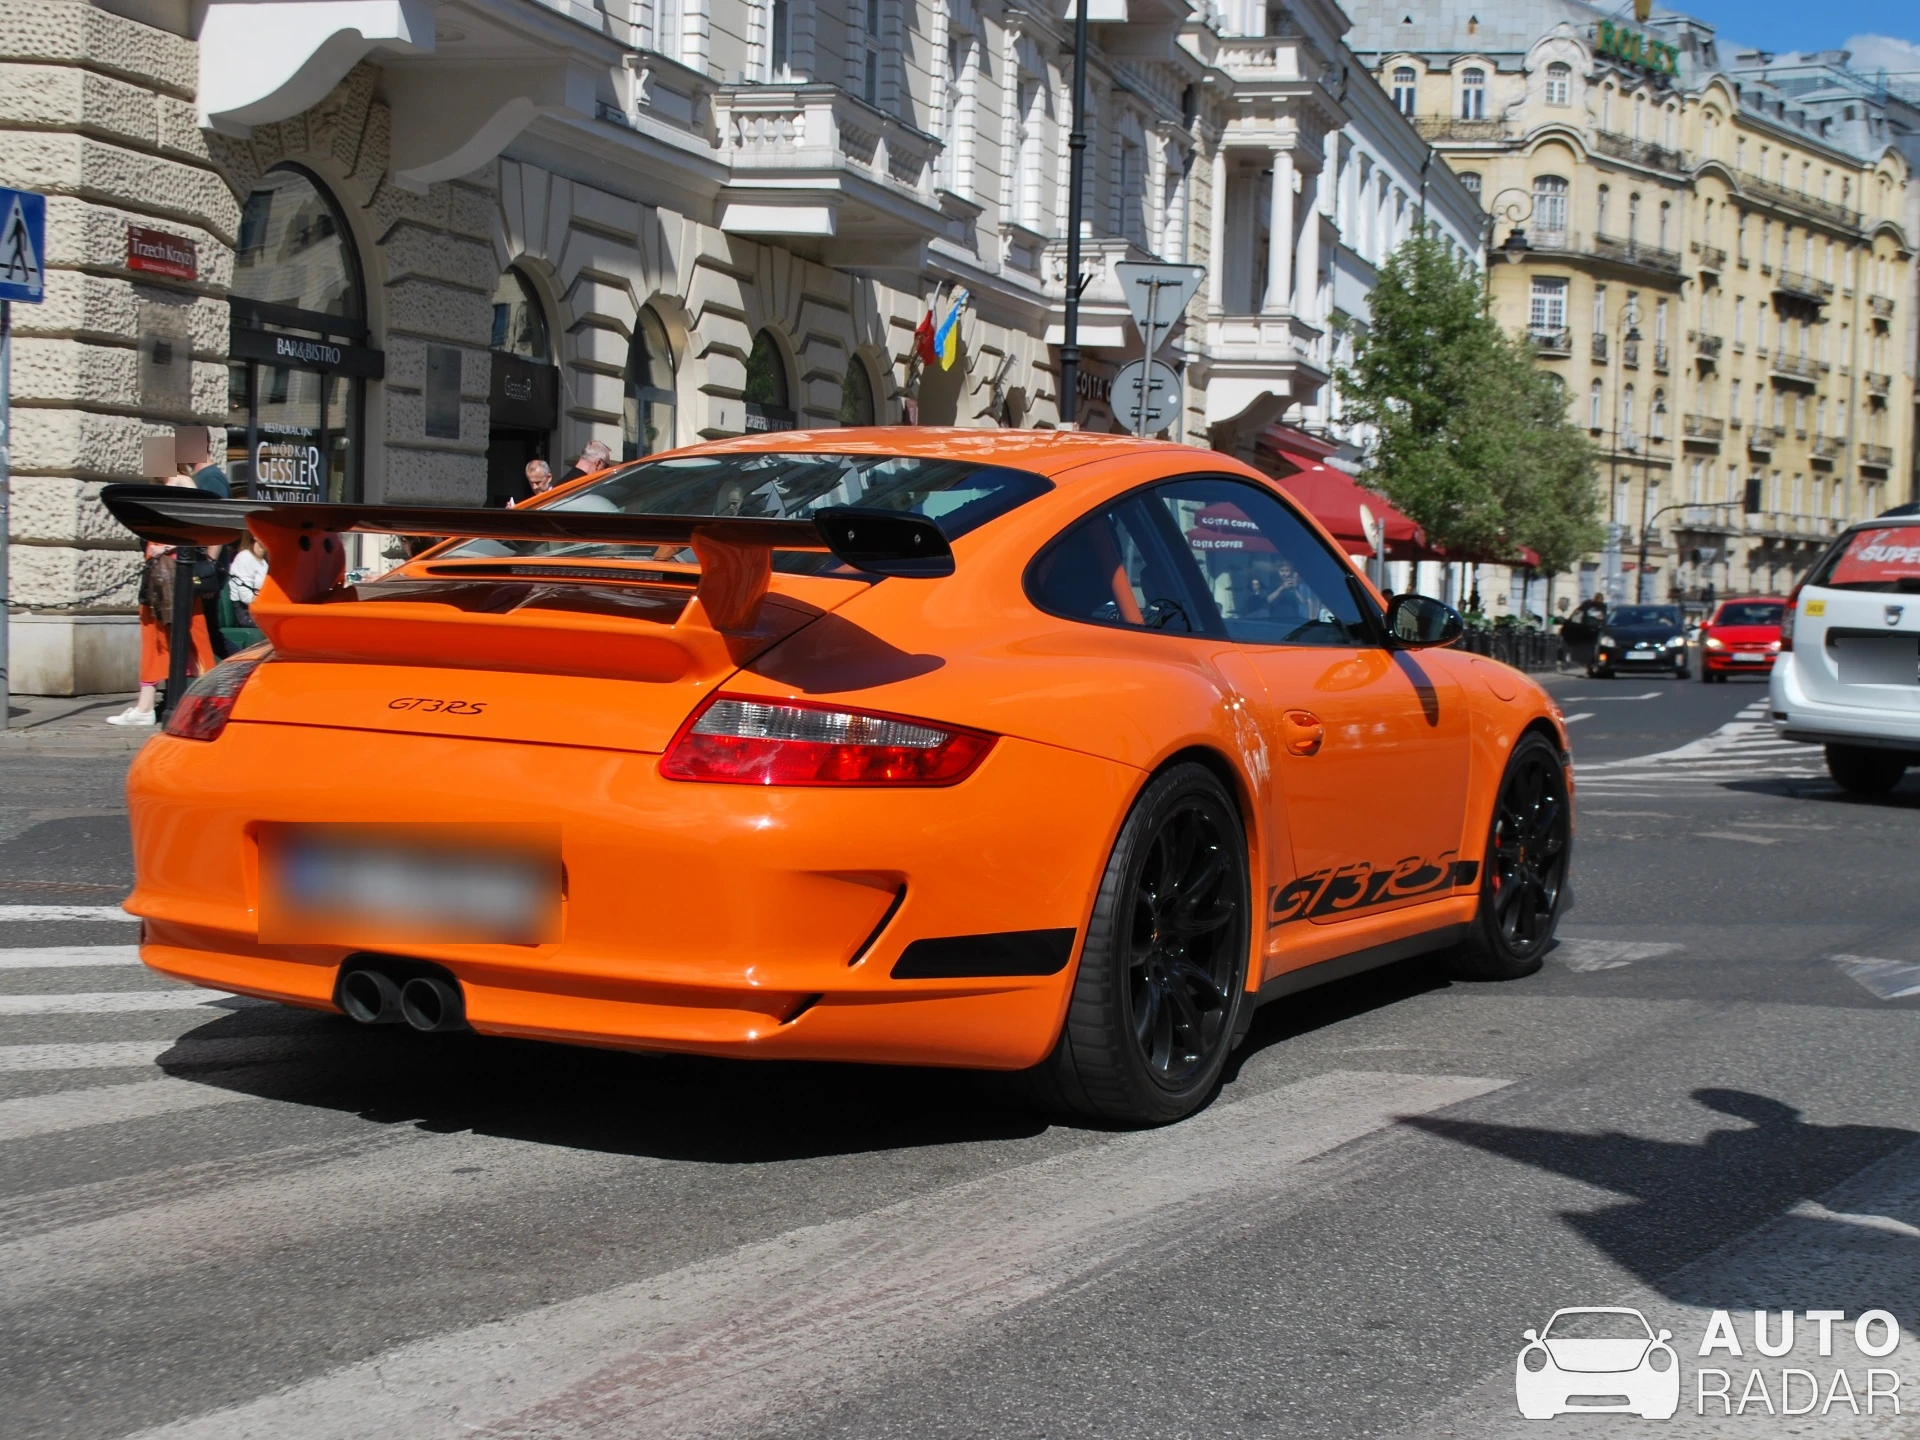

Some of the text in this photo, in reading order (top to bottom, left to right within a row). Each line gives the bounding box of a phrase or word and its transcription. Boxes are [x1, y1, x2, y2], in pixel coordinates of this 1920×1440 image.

[1596, 18, 1681, 78] ROLEX
[131, 237, 166, 260] Trzech
[276, 337, 341, 364] BAR&BISTRO
[1076, 370, 1103, 400] COSTA
[269, 441, 308, 458] WÓDKA
[256, 441, 320, 486] GESSLER
[257, 490, 271, 501] NA
[1202, 517, 1229, 526] COSTA
[1192, 539, 1243, 549] COSTA COFFEE
[1857, 545, 1920, 564] SUPE
